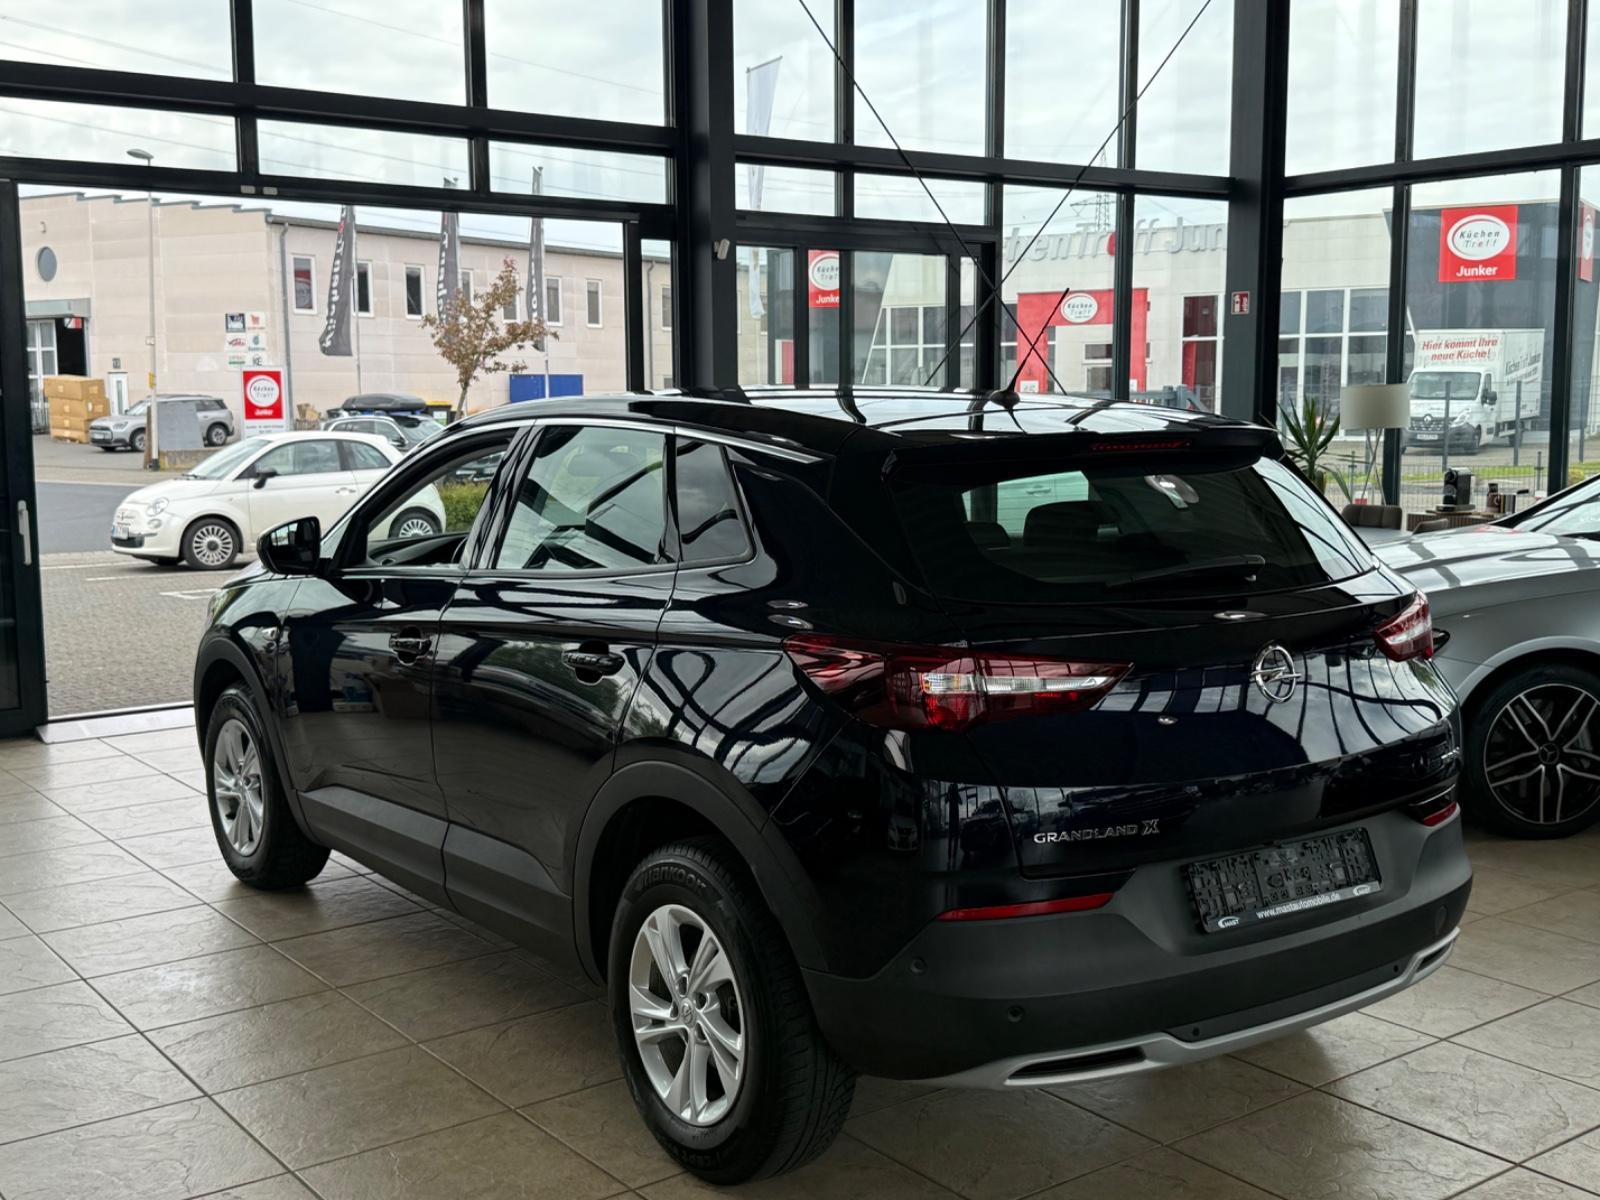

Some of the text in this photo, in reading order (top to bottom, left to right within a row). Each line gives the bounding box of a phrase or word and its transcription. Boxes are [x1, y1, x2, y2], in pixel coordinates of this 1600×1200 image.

[1168, 217, 1227, 255] Jun
[1459, 229, 1500, 239] Küchen
[1464, 239, 1498, 248] Treff
[1455, 264, 1498, 277] Junker
[815, 294, 840, 304] Junke
[1422, 337, 1498, 350] Hier kommt Ihre
[1431, 348, 1492, 361] neue Küche!
[1033, 818, 1160, 844] GRANDLAND X
[1256, 891, 1341, 920] www.mastautomobile.de
